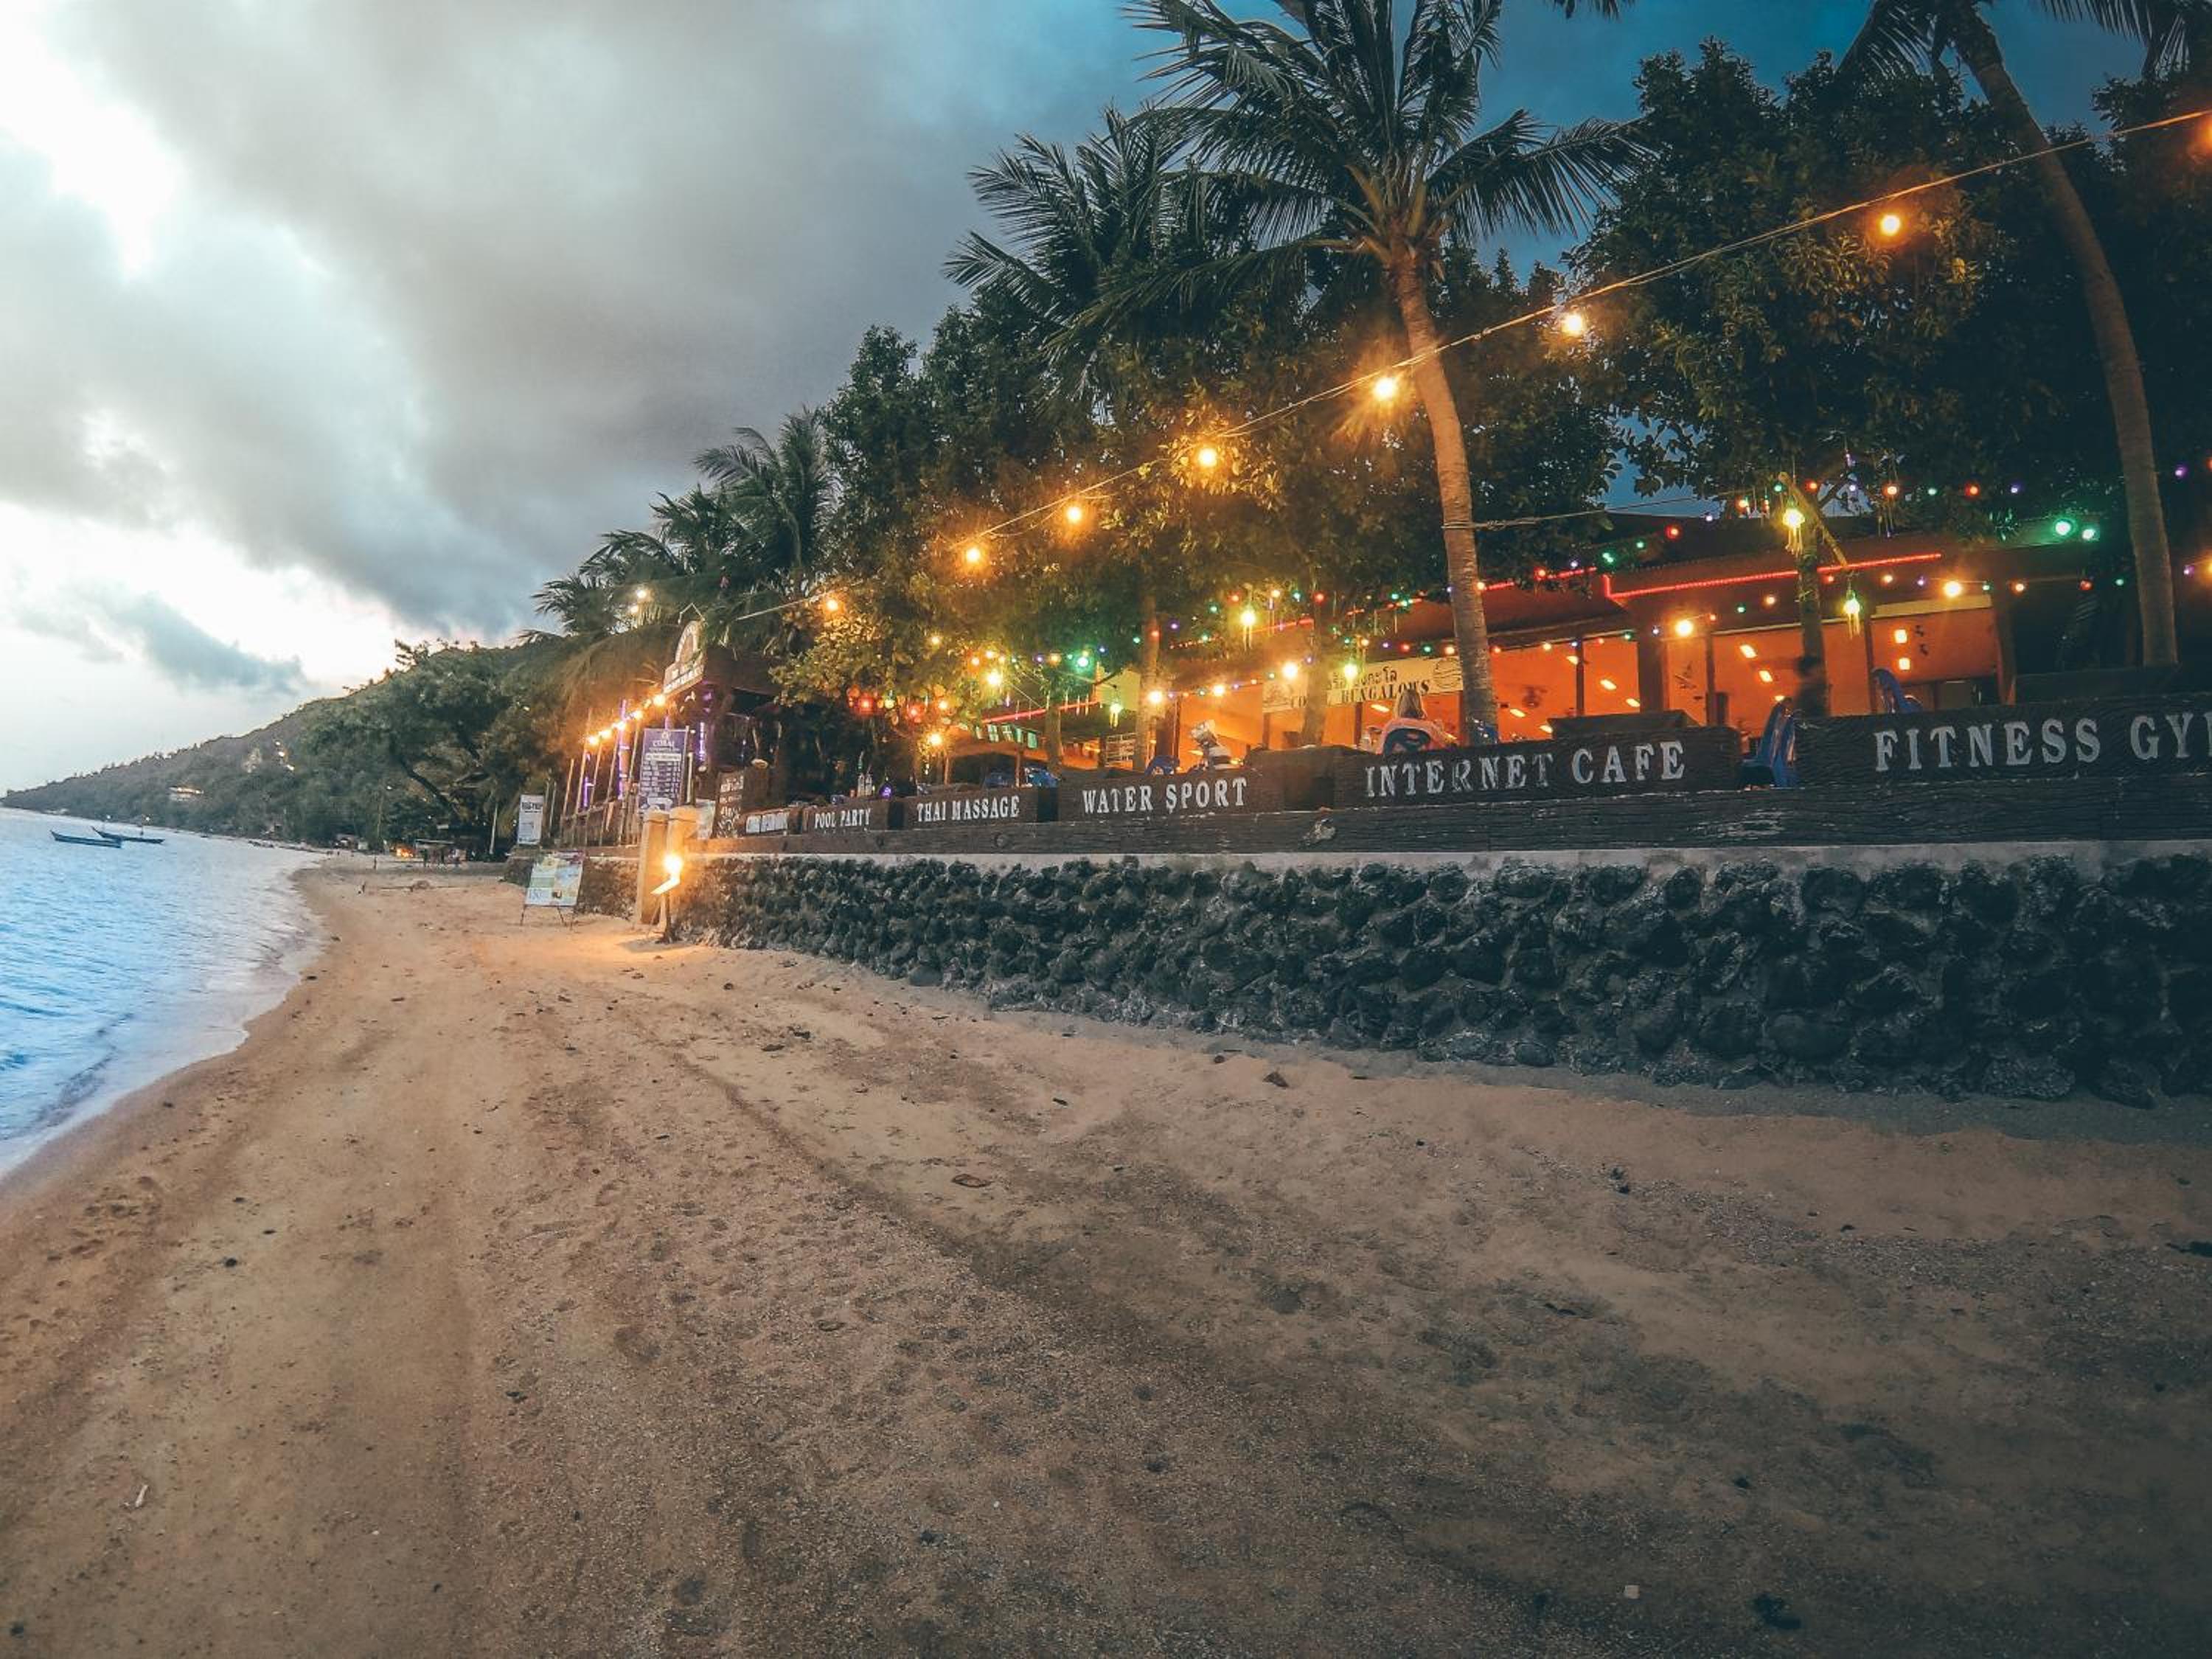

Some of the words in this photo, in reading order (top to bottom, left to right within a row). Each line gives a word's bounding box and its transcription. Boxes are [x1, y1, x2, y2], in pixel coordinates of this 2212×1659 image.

[1874, 717, 2101, 772] FITNESS
[1364, 753, 1554, 797] INTERNET
[1571, 740, 1686, 785] CAFE
[917, 801, 947, 822] THAI
[951, 795, 1020, 821] MASSAGE
[1082, 785, 1154, 814] WATER
[1165, 776, 1248, 813] SPORT
[814, 813, 837, 829] POOL
[840, 807, 872, 827] PARTY
